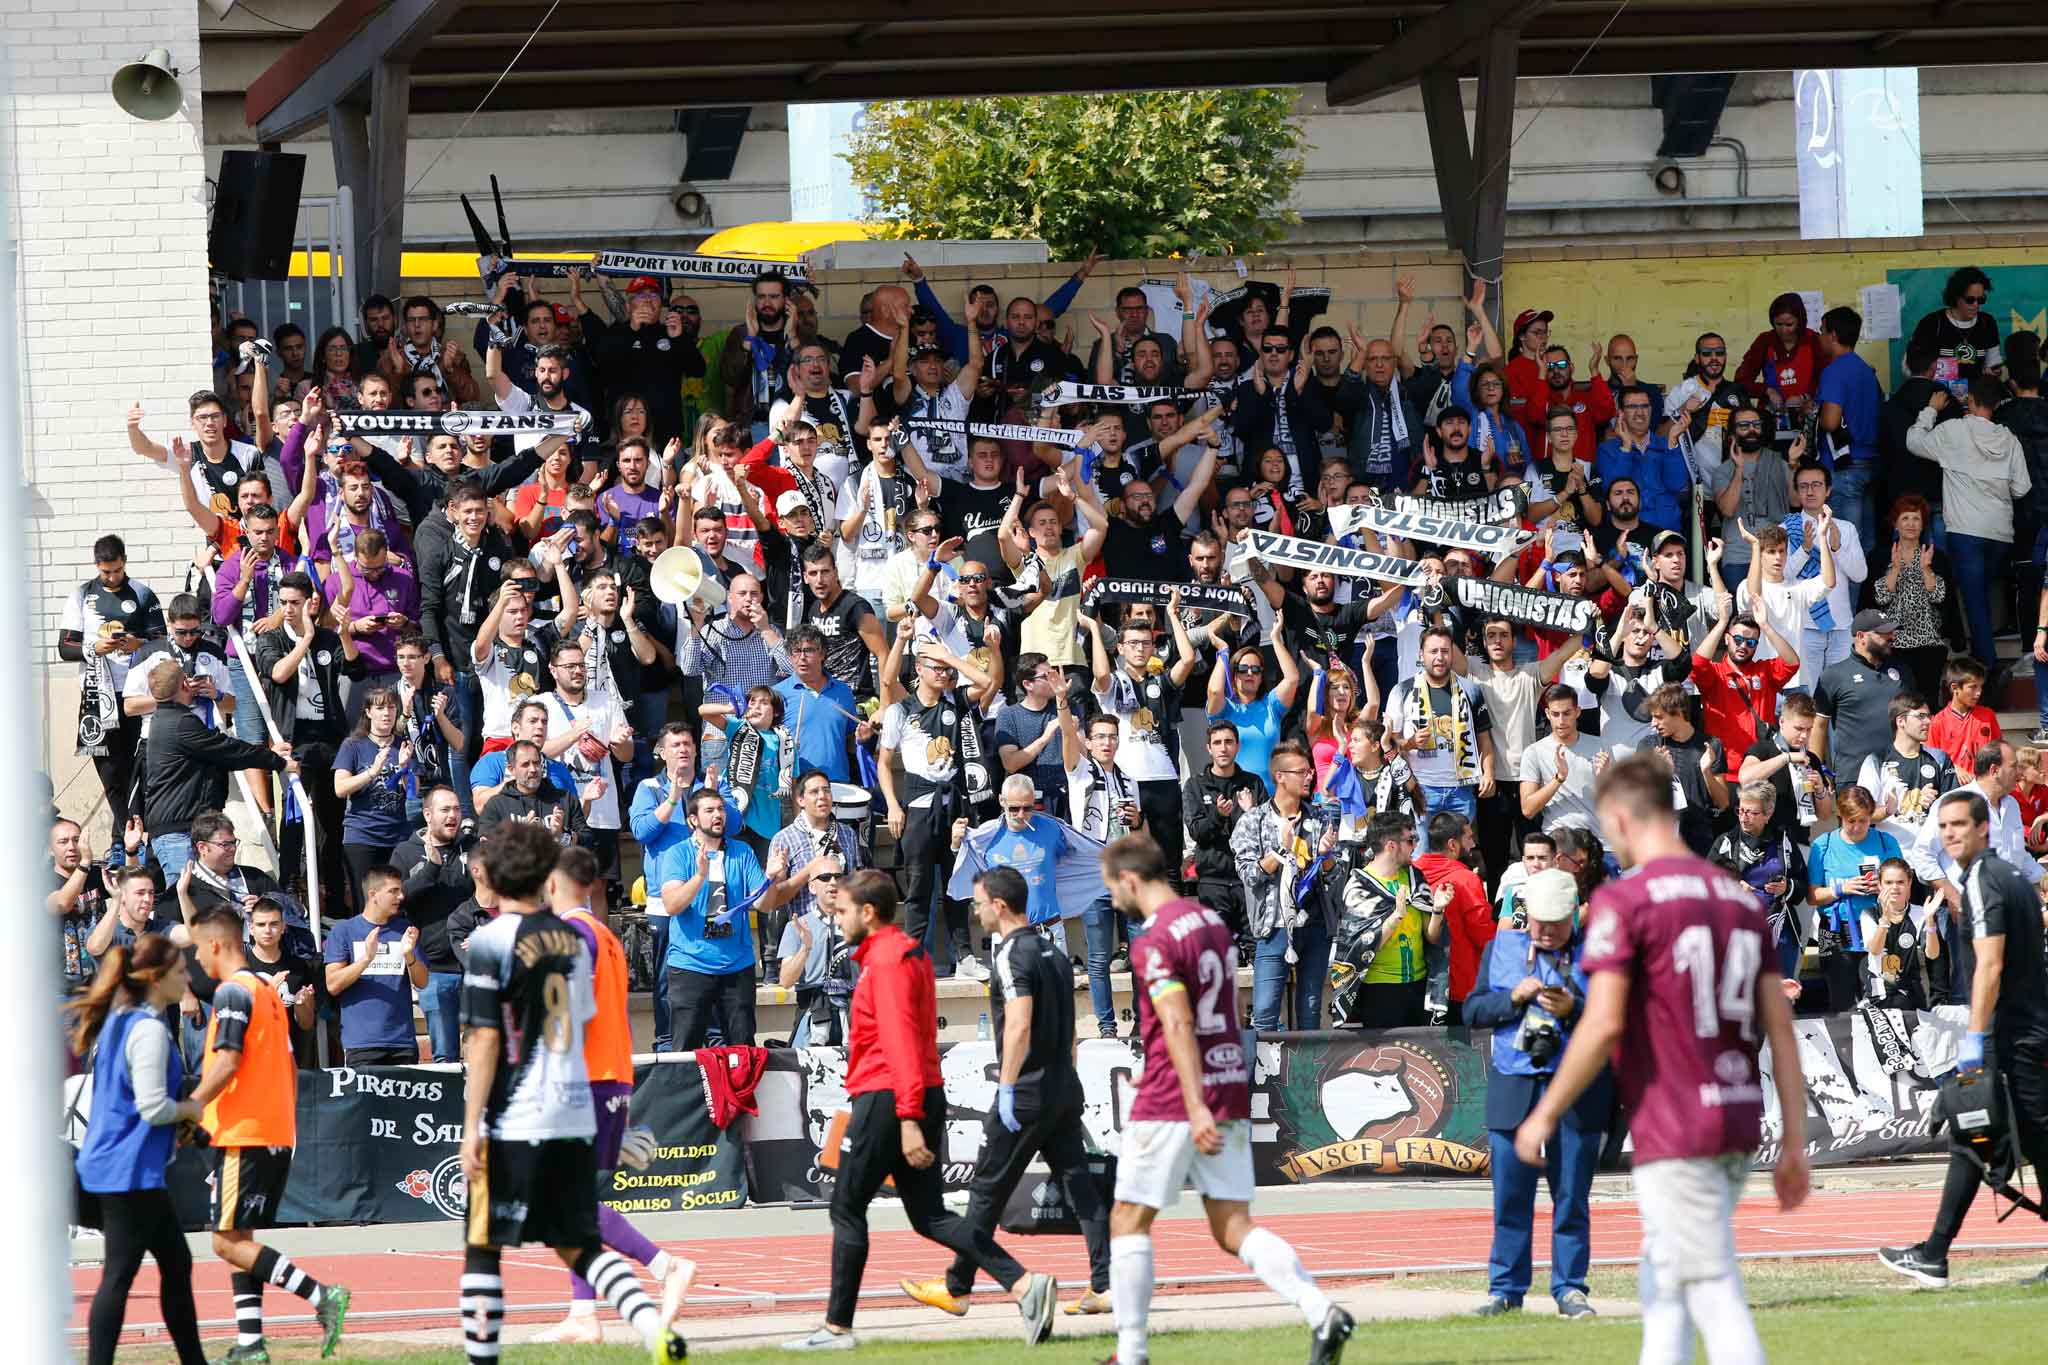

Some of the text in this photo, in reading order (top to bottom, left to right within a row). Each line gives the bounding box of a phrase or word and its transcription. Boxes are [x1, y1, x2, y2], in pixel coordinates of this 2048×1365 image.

[671, 258, 712, 273] YOUR
[717, 262, 763, 276] LOCAL
[1076, 384, 1126, 401] LAS
[340, 414, 556, 431] YOUTH FANS
[1108, 581, 1154, 595] HUBO
[1456, 577, 1592, 632] UNIONISTAS
[1672, 924, 1763, 1042] 14
[543, 972, 573, 1055] 8
[322, 1067, 444, 1101] PIRATAS
[370, 1112, 466, 1146] DE SAL
[654, 1143, 718, 1160] UALDAD
[1304, 1142, 1476, 1172] VSCF FANS
[612, 1170, 717, 1191] SOLIDARIDAD
[680, 1190, 741, 1210] SOCIAL
